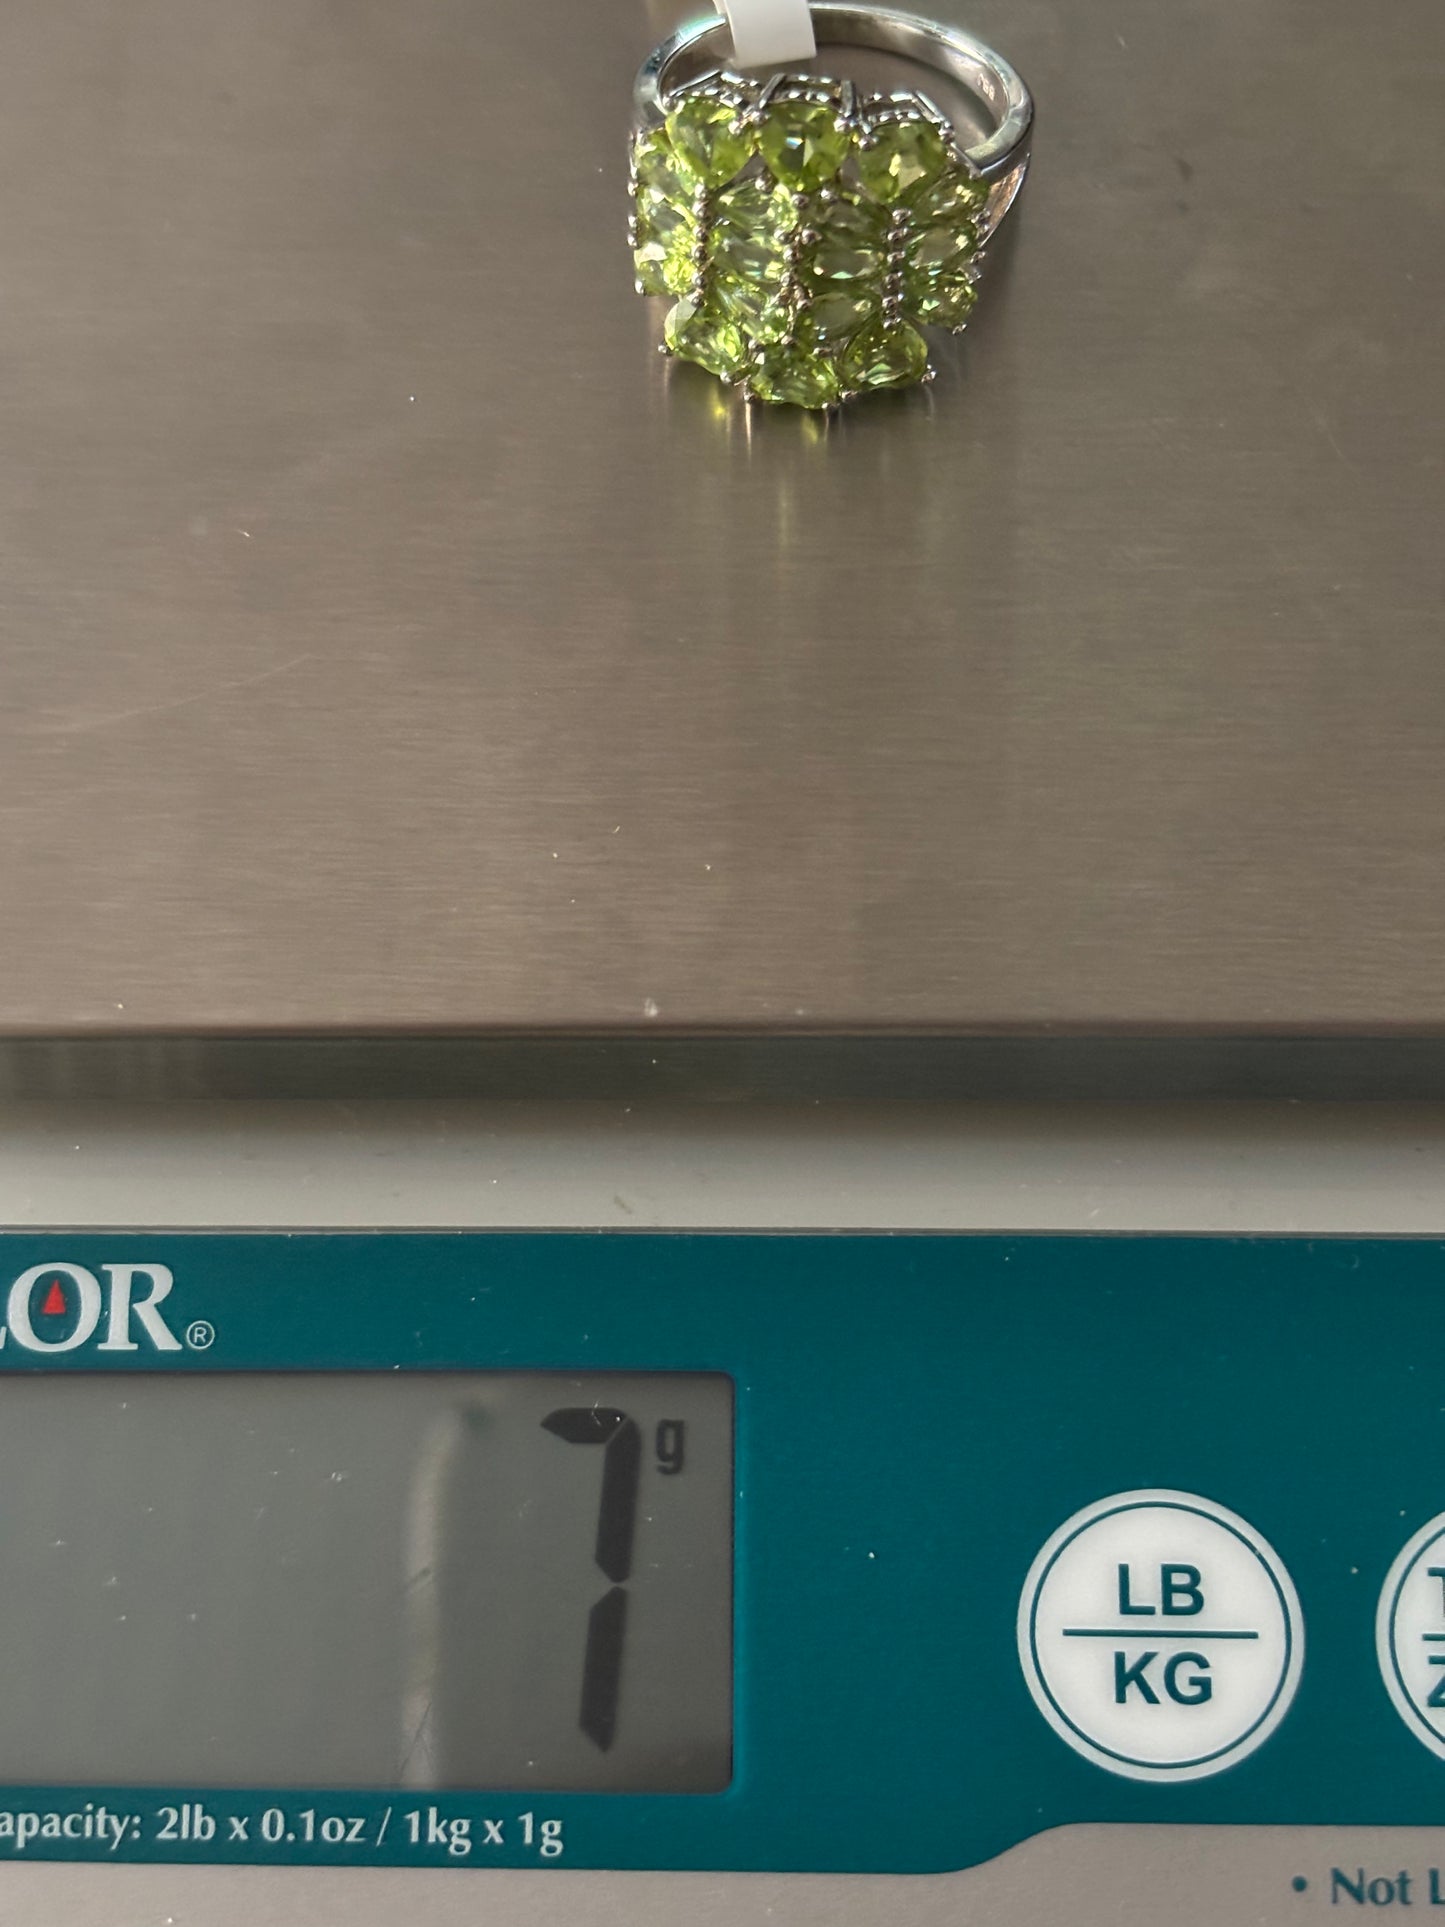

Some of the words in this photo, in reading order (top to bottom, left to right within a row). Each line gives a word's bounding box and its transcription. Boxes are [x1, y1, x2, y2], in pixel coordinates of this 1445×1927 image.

[1117, 1563, 1205, 1616] LB
[1114, 1651, 1213, 1706] KG
[0, 1803, 142, 1850] apacity:
[156, 1803, 216, 1841] 2lb
[228, 1816, 249, 1840] x
[261, 1808, 367, 1842] 0.1oz
[375, 1806, 392, 1847] /
[403, 1806, 472, 1856] 1kg
[482, 1819, 504, 1844] x
[518, 1811, 564, 1857] 1g
[1331, 1867, 1413, 1905] Not
